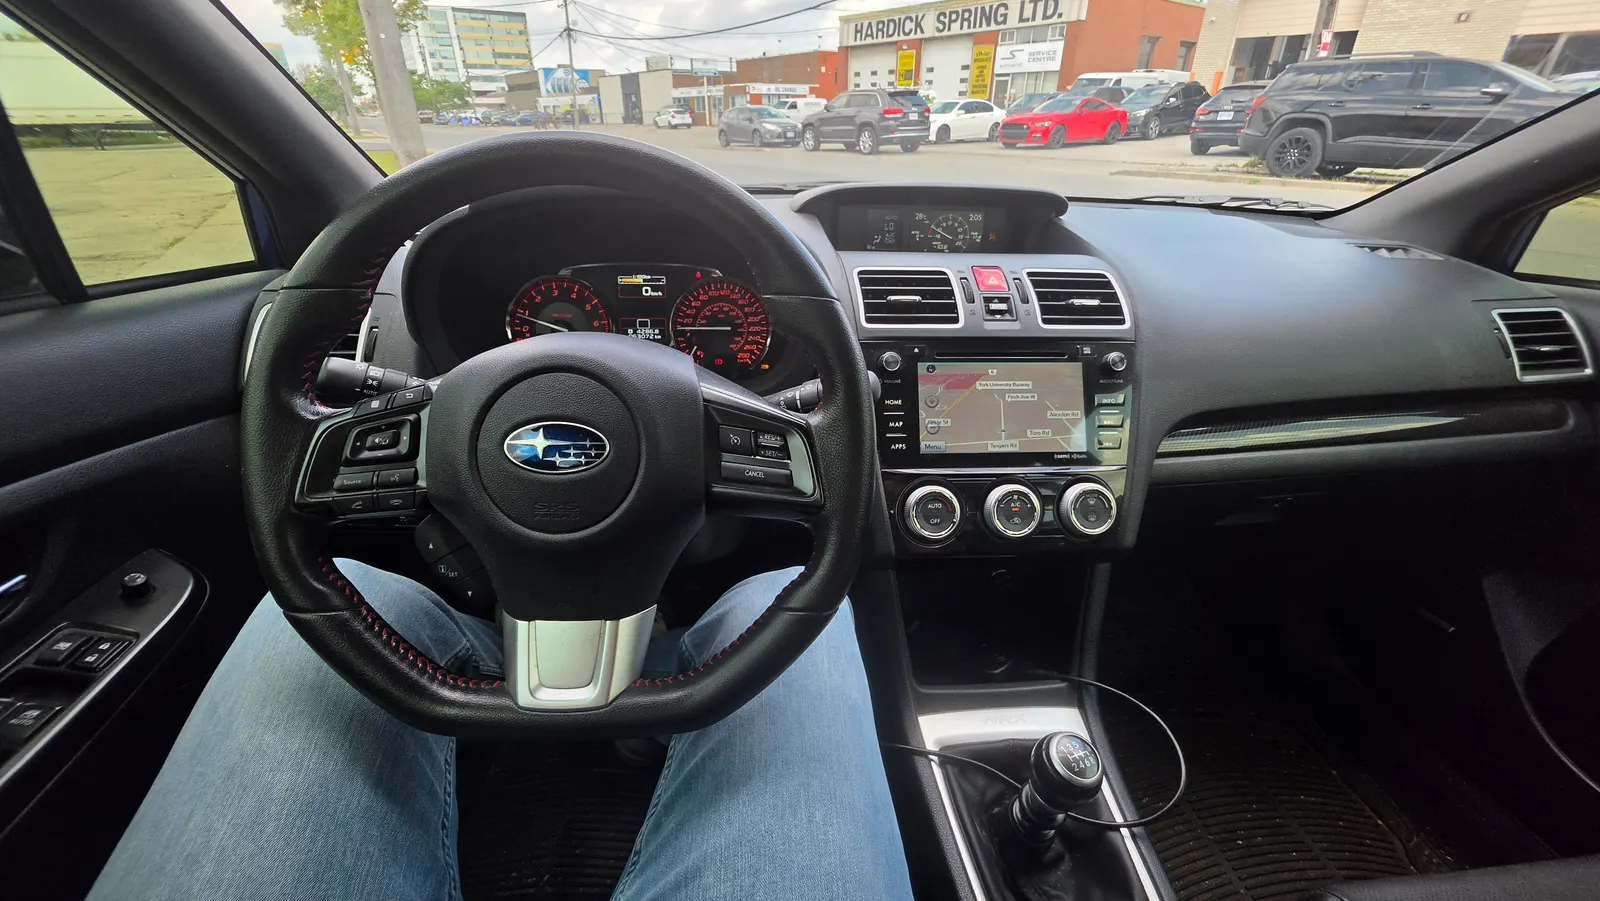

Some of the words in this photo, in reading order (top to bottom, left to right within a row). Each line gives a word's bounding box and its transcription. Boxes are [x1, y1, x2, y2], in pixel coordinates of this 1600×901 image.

[854, 13, 926, 42] HARDICK
[935, 3, 1009, 33] SPRING
[1018, 0, 1063, 24] LTD.
[745, 470, 765, 478] CANCEL
[1060, 745, 1068, 754] 1
[1066, 743, 1073, 751] 3
[1072, 741, 1080, 749] 5
[1071, 762, 1079, 772] 2
[1079, 759, 1085, 769] 4
[1084, 758, 1091, 767] 6
[1088, 756, 1096, 765] R
